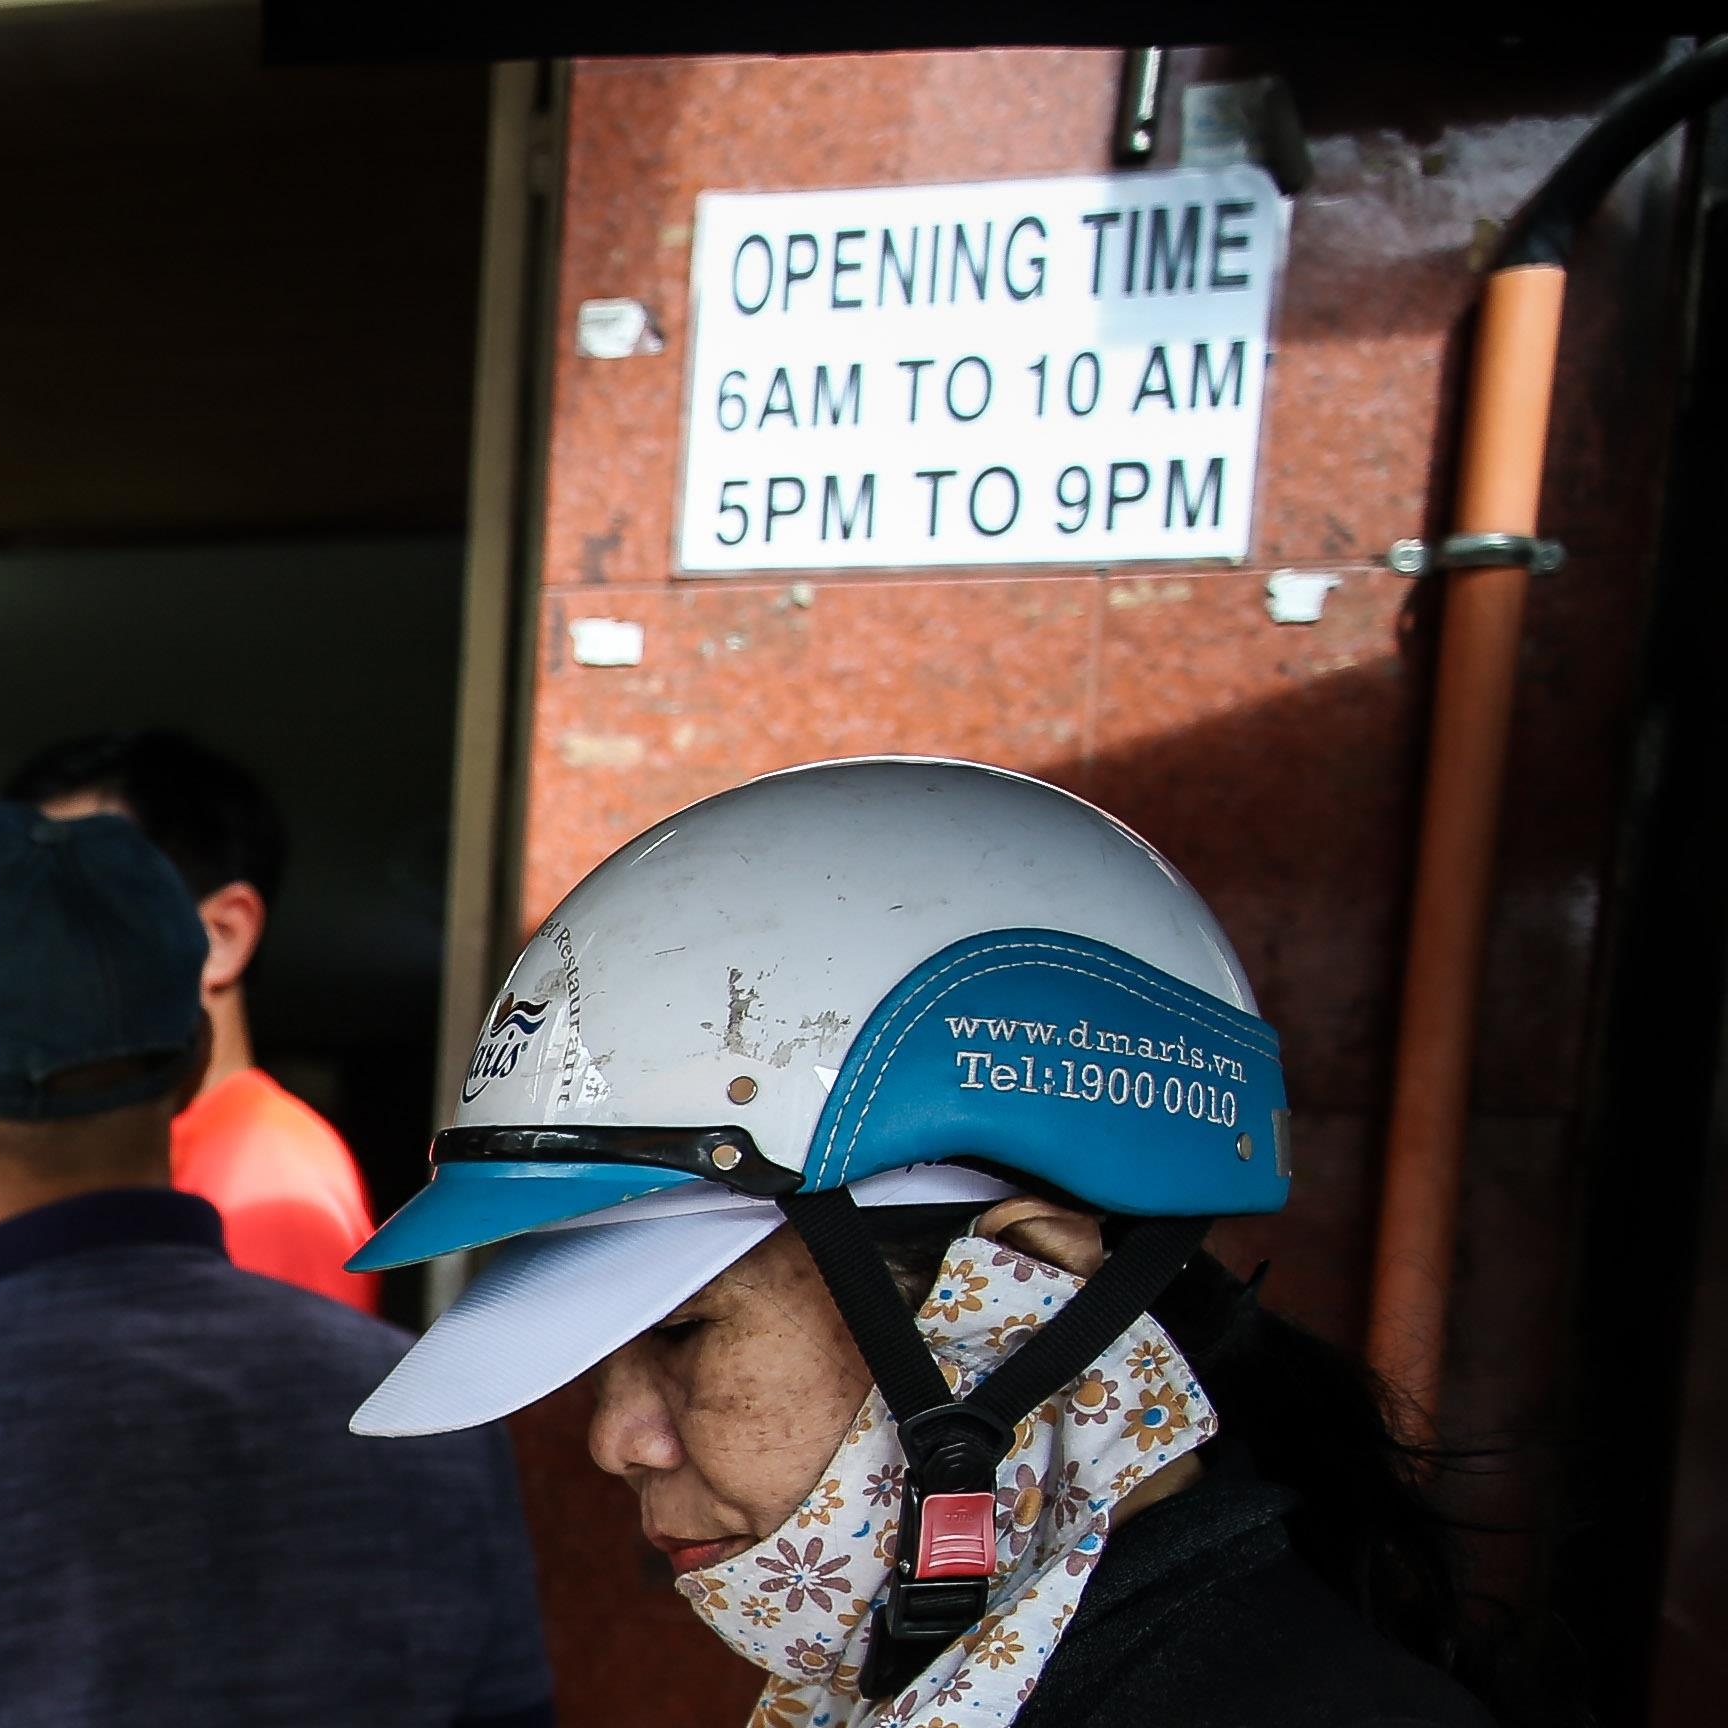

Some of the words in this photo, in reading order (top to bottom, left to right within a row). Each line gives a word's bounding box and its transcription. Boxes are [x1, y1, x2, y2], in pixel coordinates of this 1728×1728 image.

[731, 215, 1046, 316] OPENING
[1081, 201, 1256, 298] TIME
[717, 363, 863, 432] 6AM
[897, 354, 993, 424] TO
[1029, 350, 1101, 417] 10
[1132, 340, 1247, 413] AM
[714, 472, 876, 547] 5PM
[915, 465, 1021, 538] TO
[1054, 456, 1225, 535] 9PM
[944, 1015, 1248, 1084] www.dmaris.vn
